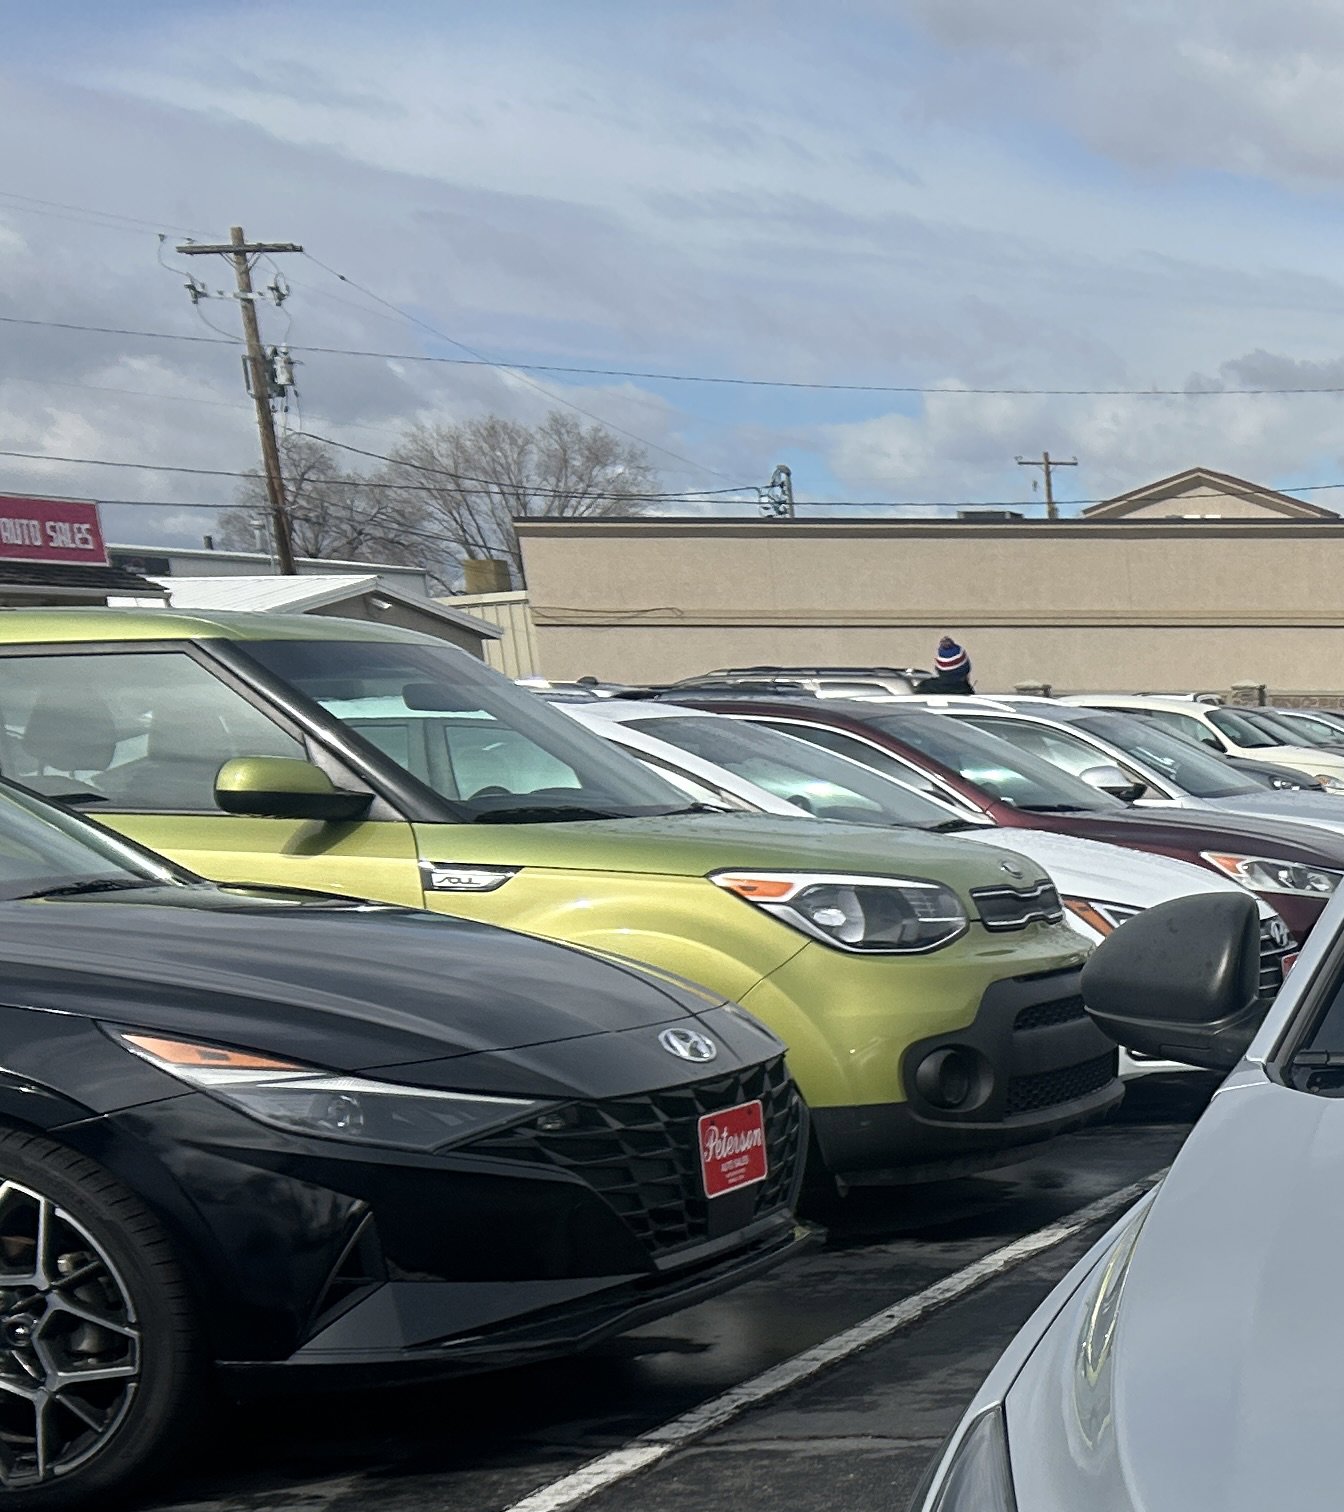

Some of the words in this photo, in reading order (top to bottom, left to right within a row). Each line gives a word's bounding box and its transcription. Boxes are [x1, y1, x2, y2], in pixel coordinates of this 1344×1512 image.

[0, 517, 43, 546] AUTO
[45, 520, 94, 549] SALES
[704, 1126, 761, 1162] Peterson
